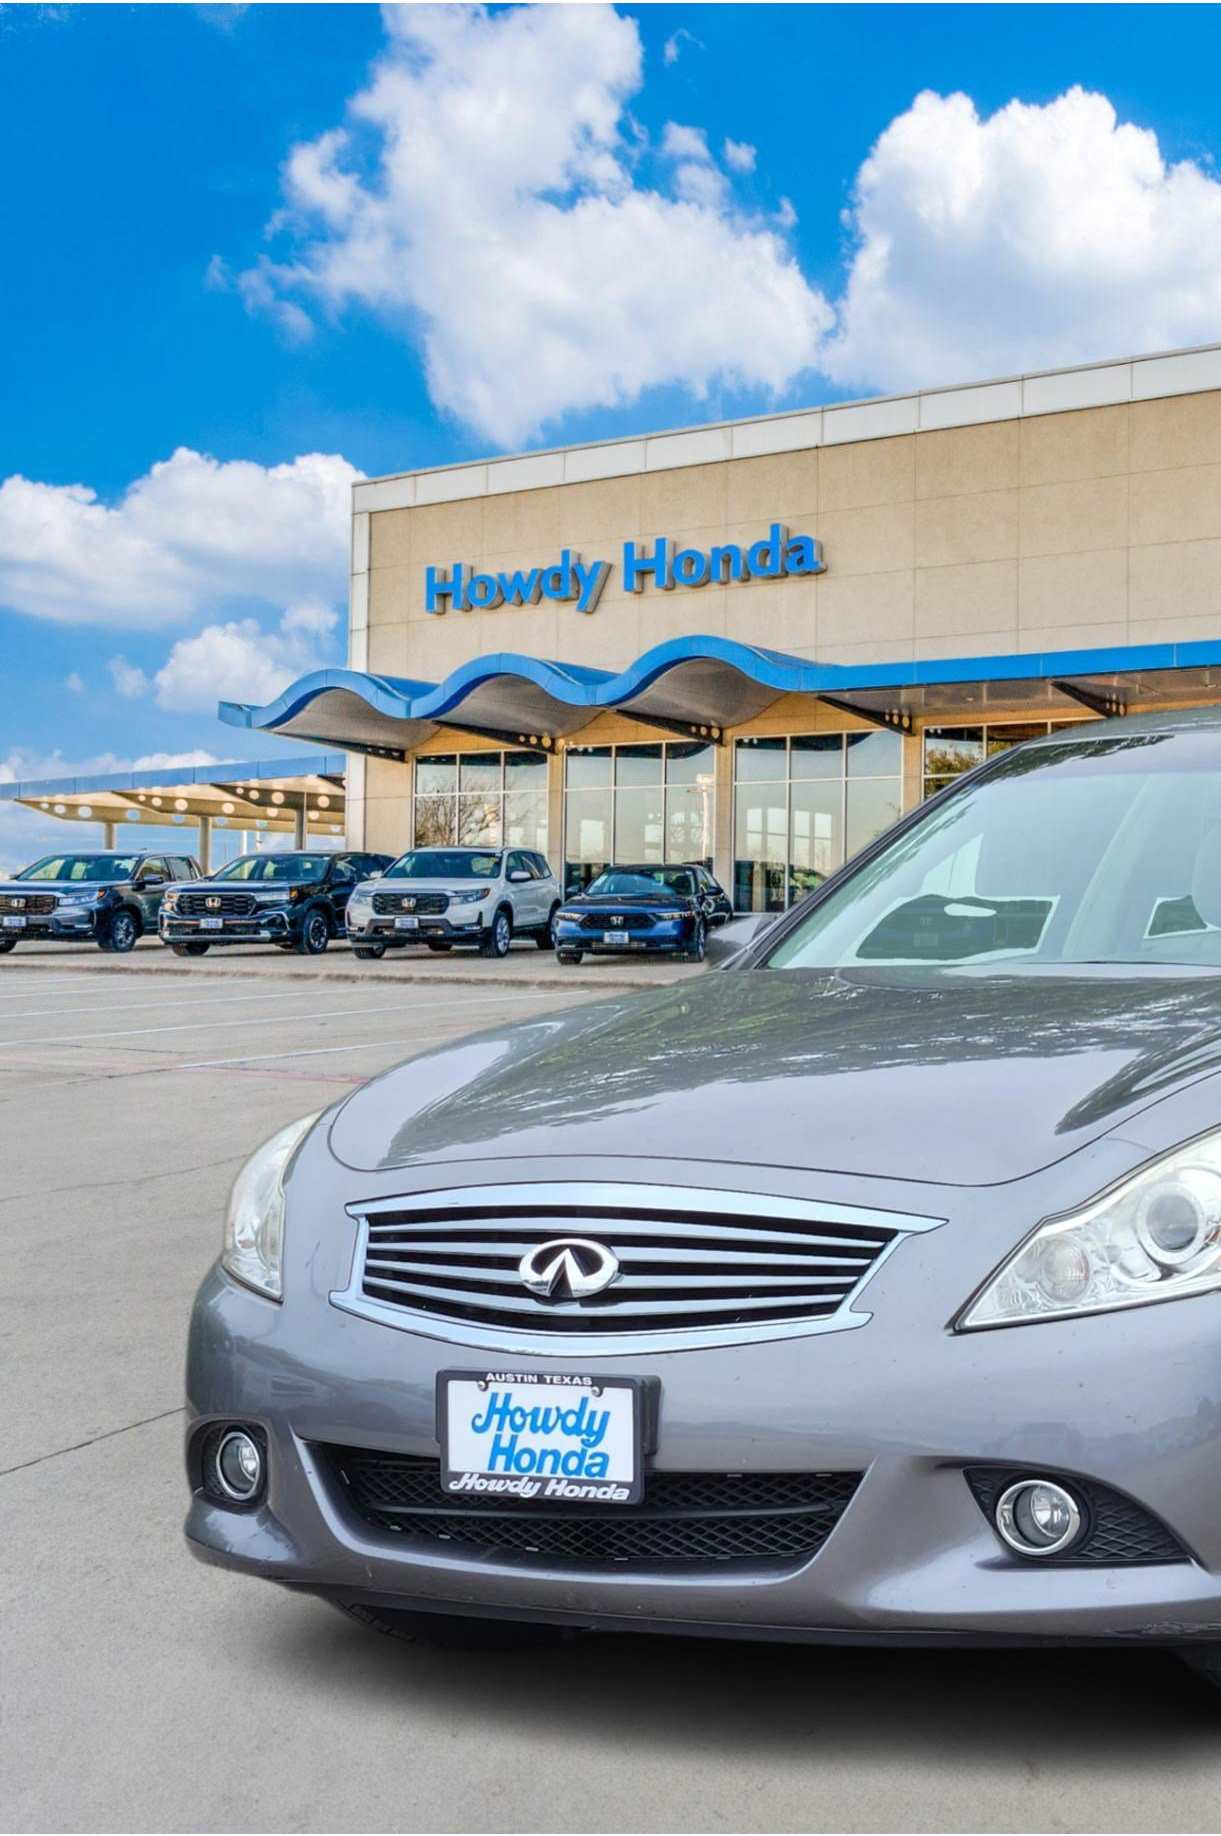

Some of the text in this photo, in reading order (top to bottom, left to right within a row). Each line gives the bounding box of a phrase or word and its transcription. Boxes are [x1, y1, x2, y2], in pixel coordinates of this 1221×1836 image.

[425, 522, 827, 615] Howdy Honda
[485, 1371, 593, 1387] AUSTIN TEXAS
[472, 1392, 610, 1447] Howdy
[488, 1434, 610, 1478] Honda
[450, 1472, 629, 1500] Howdy Honda
